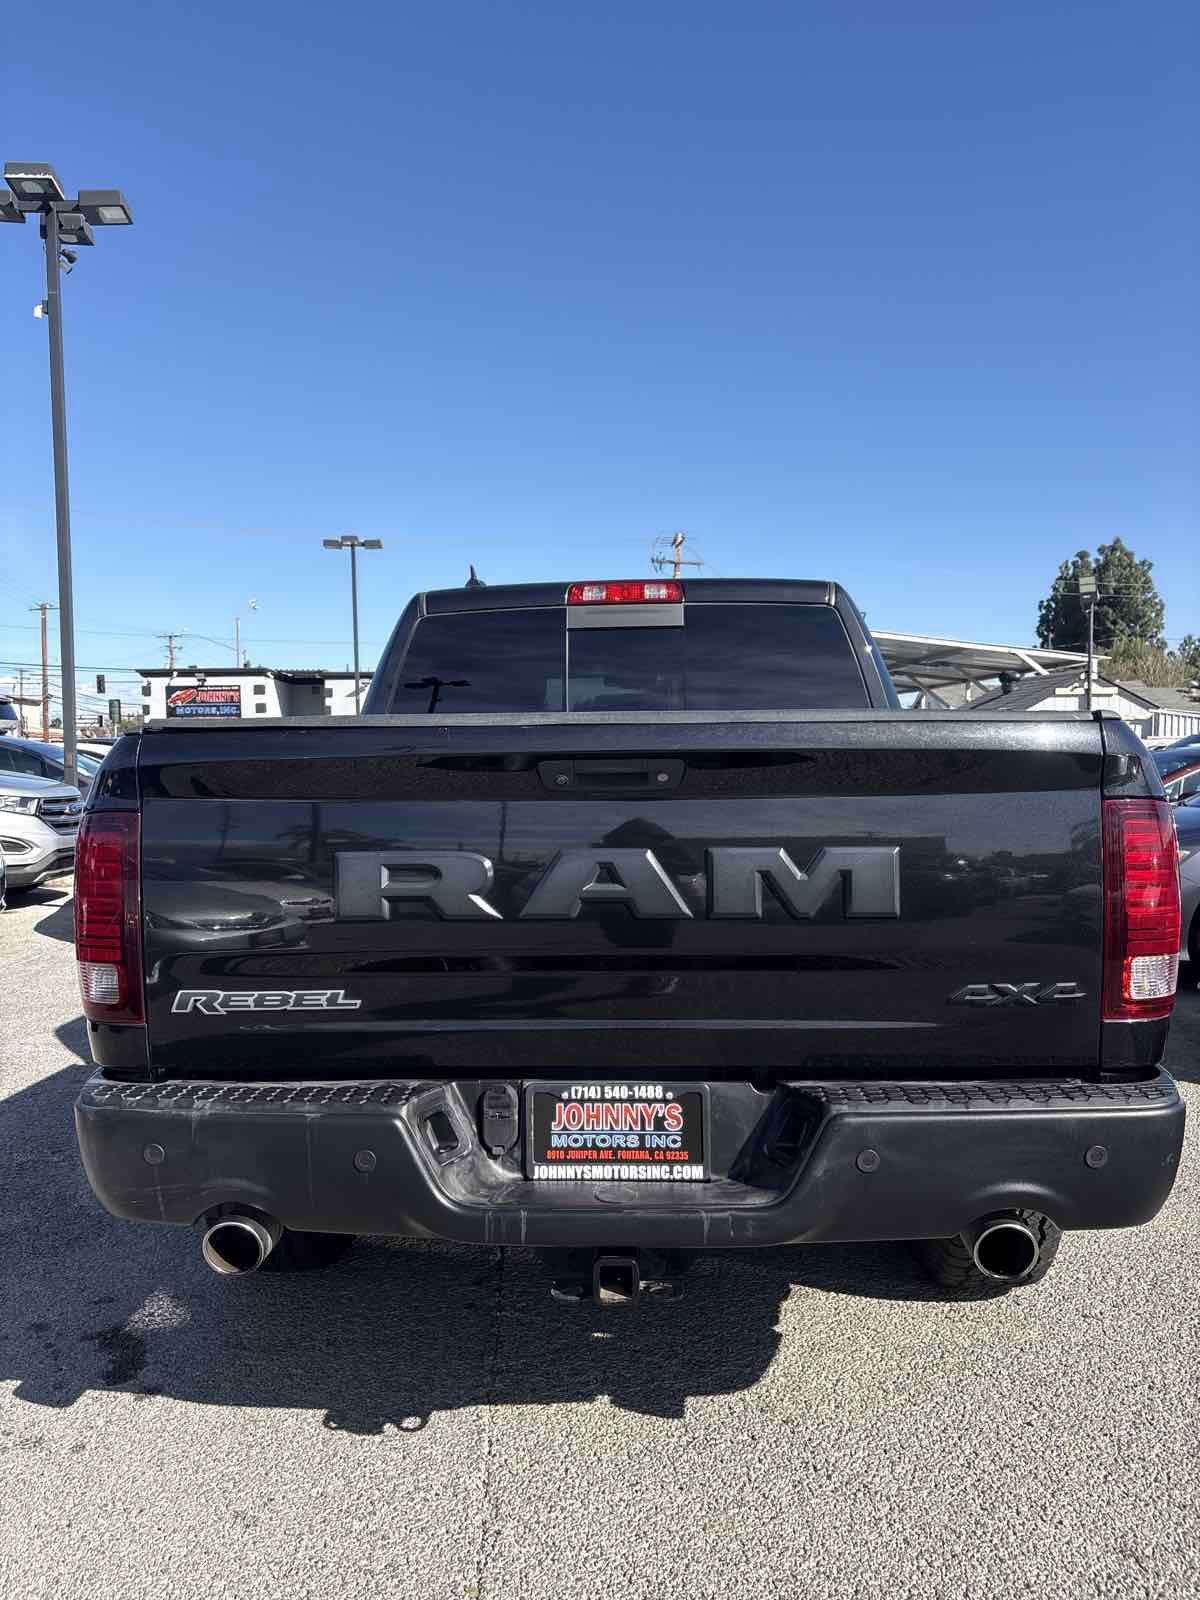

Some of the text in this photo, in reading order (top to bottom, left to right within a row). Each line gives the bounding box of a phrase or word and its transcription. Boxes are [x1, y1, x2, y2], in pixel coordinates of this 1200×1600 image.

[334, 847, 902, 920] RAM
[171, 989, 362, 1015] REBEL
[949, 980, 1087, 1007] 4X4
[571, 1086, 601, 1099] (714)
[552, 1102, 684, 1131] JOHNNY'S
[551, 1134, 682, 1148] MOTORS INC
[566, 1150, 597, 1160] JUNIPER
[617, 1150, 653, 1161] FONTANA,
[654, 1150, 665, 1160] CA
[533, 1165, 704, 1180] JOHNNYSMOTORSINC.COM
